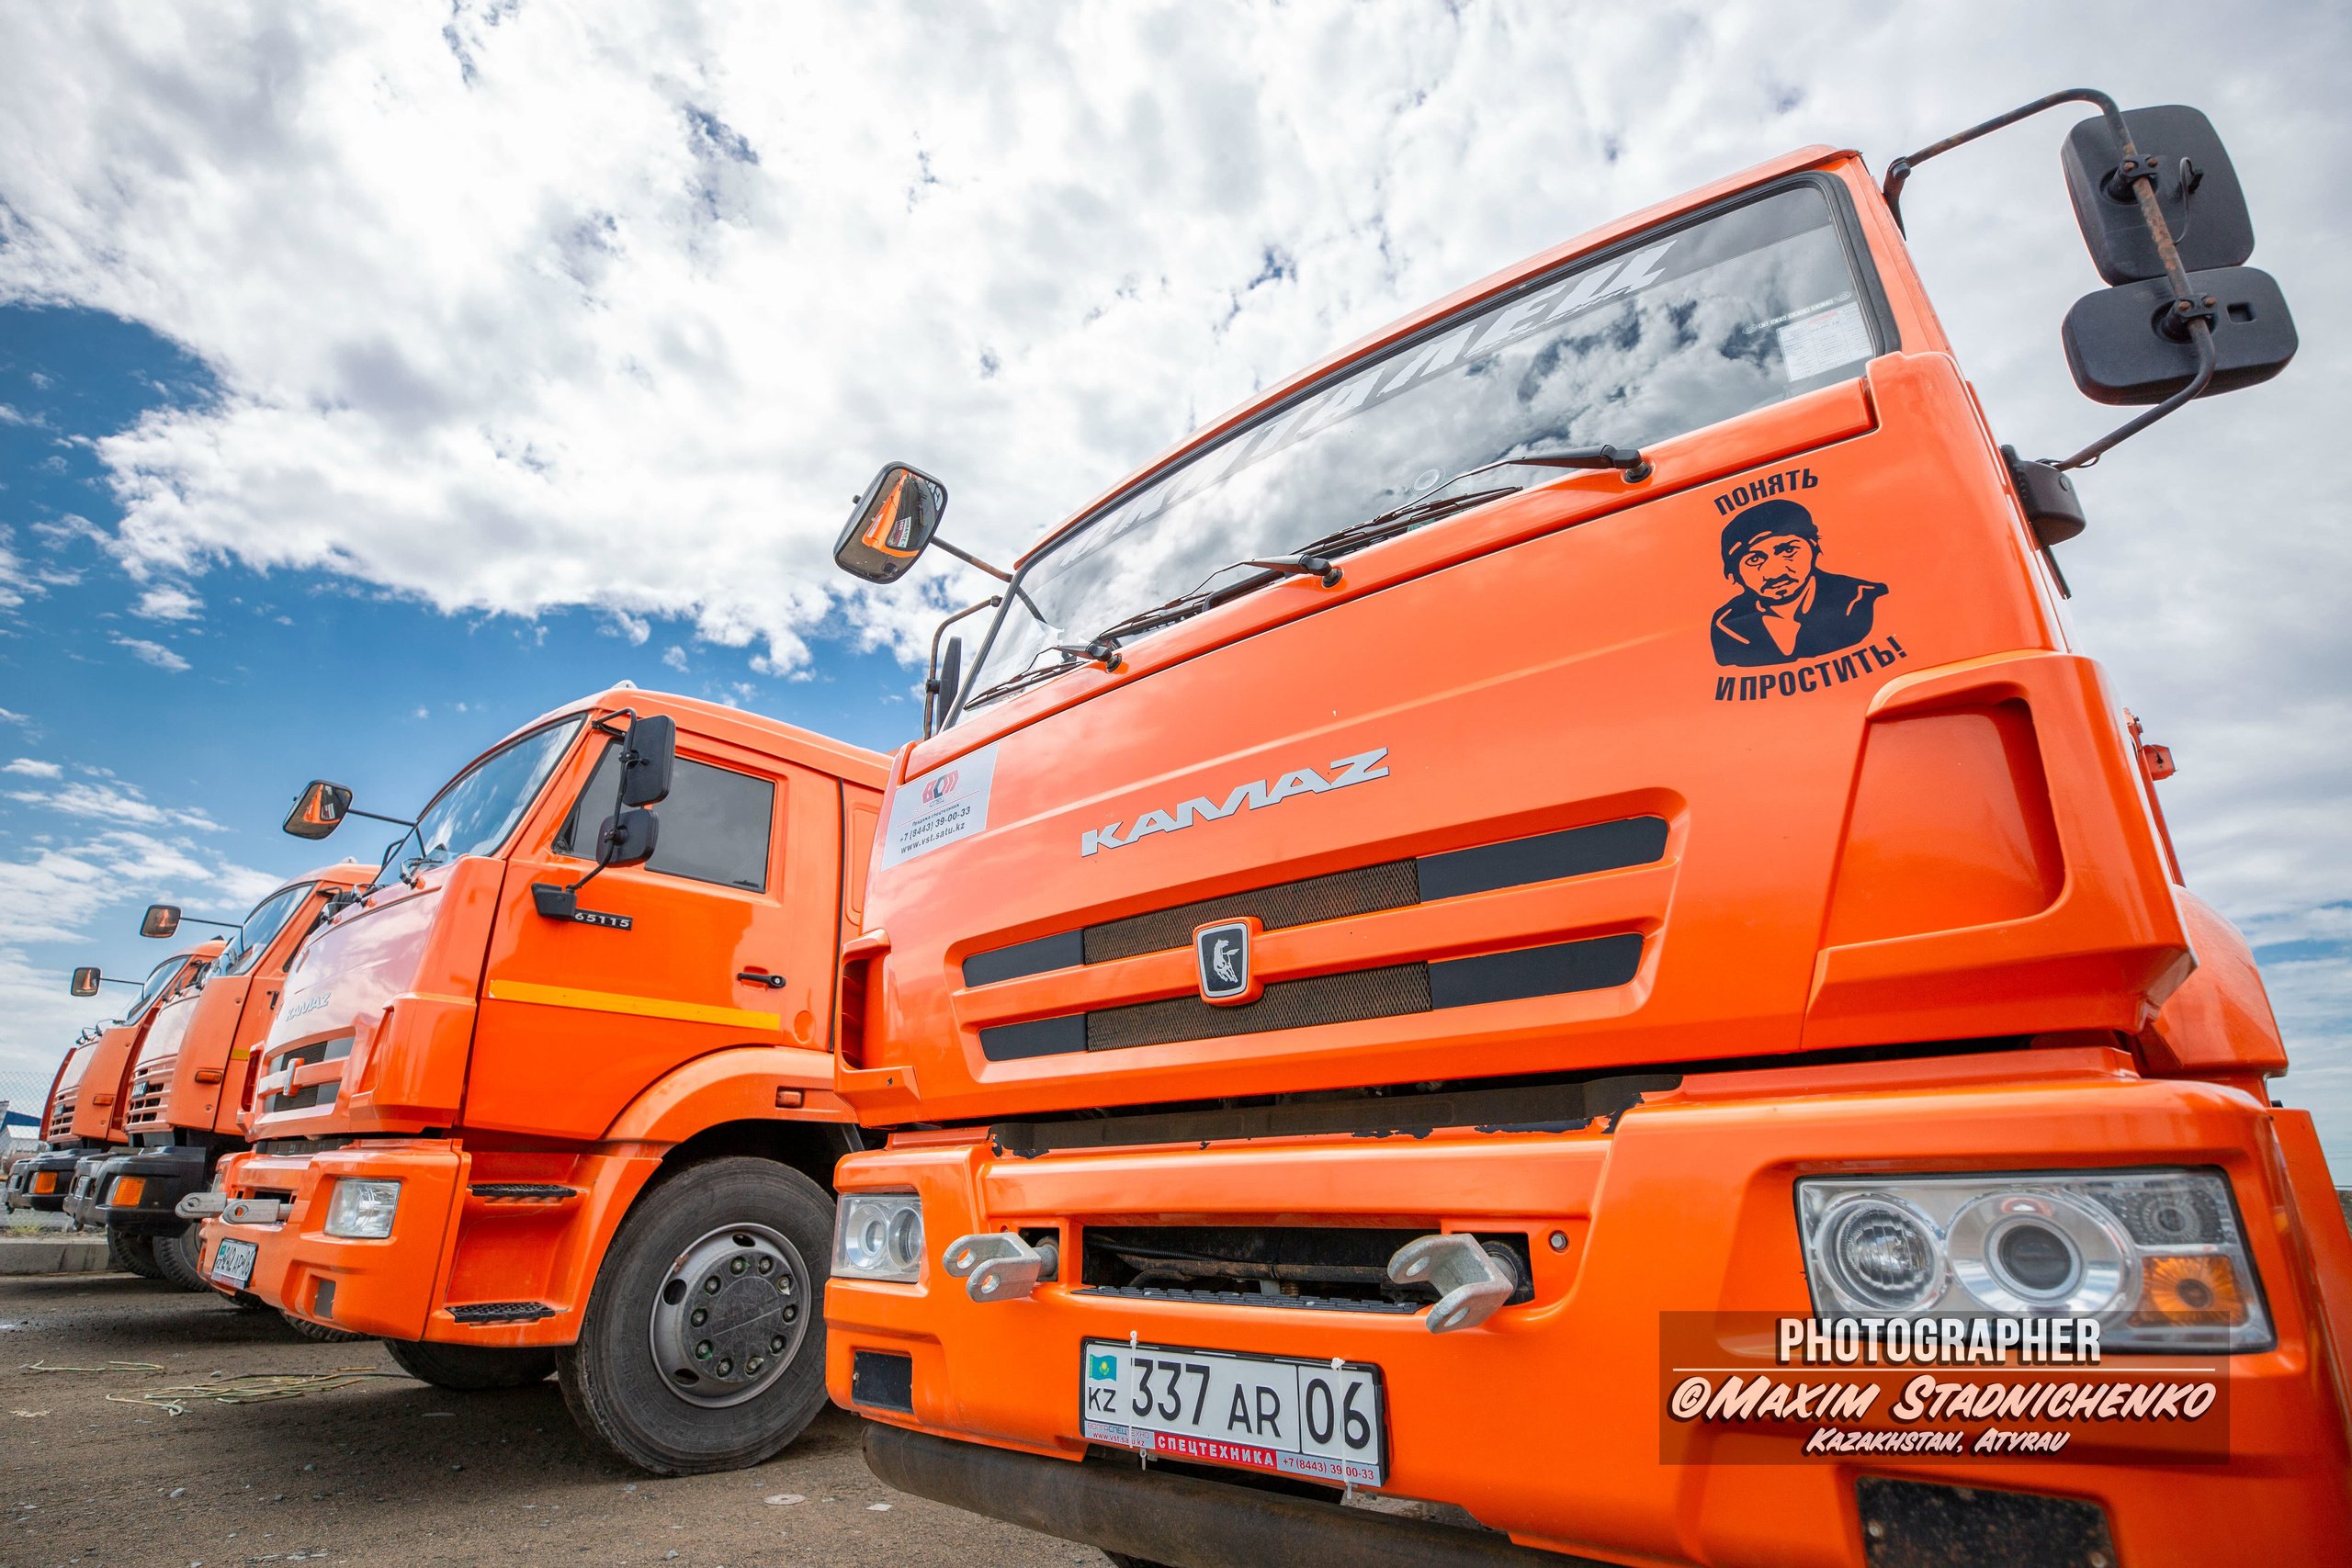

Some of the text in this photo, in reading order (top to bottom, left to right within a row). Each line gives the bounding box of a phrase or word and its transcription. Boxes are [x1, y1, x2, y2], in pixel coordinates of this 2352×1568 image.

[1713, 468, 1818, 516] ПОНЯТЬ
[1081, 747, 1390, 858] KAMAZ
[900, 822, 966, 854] www.vst.satu.kz
[910, 822, 933, 840] (8443)
[935, 806, 971, 828] 39-00-33
[574, 912, 629, 928] 65115
[1088, 1358, 1372, 1450] KZ 337 AR 06
[1092, 1432, 1146, 1447] www.vst.sau.kz
[1158, 1435, 1275, 1467] СПЕЦТЕХНИКА
[1283, 1458, 1295, 1468] +7
[1295, 1457, 1328, 1474] (8443)
